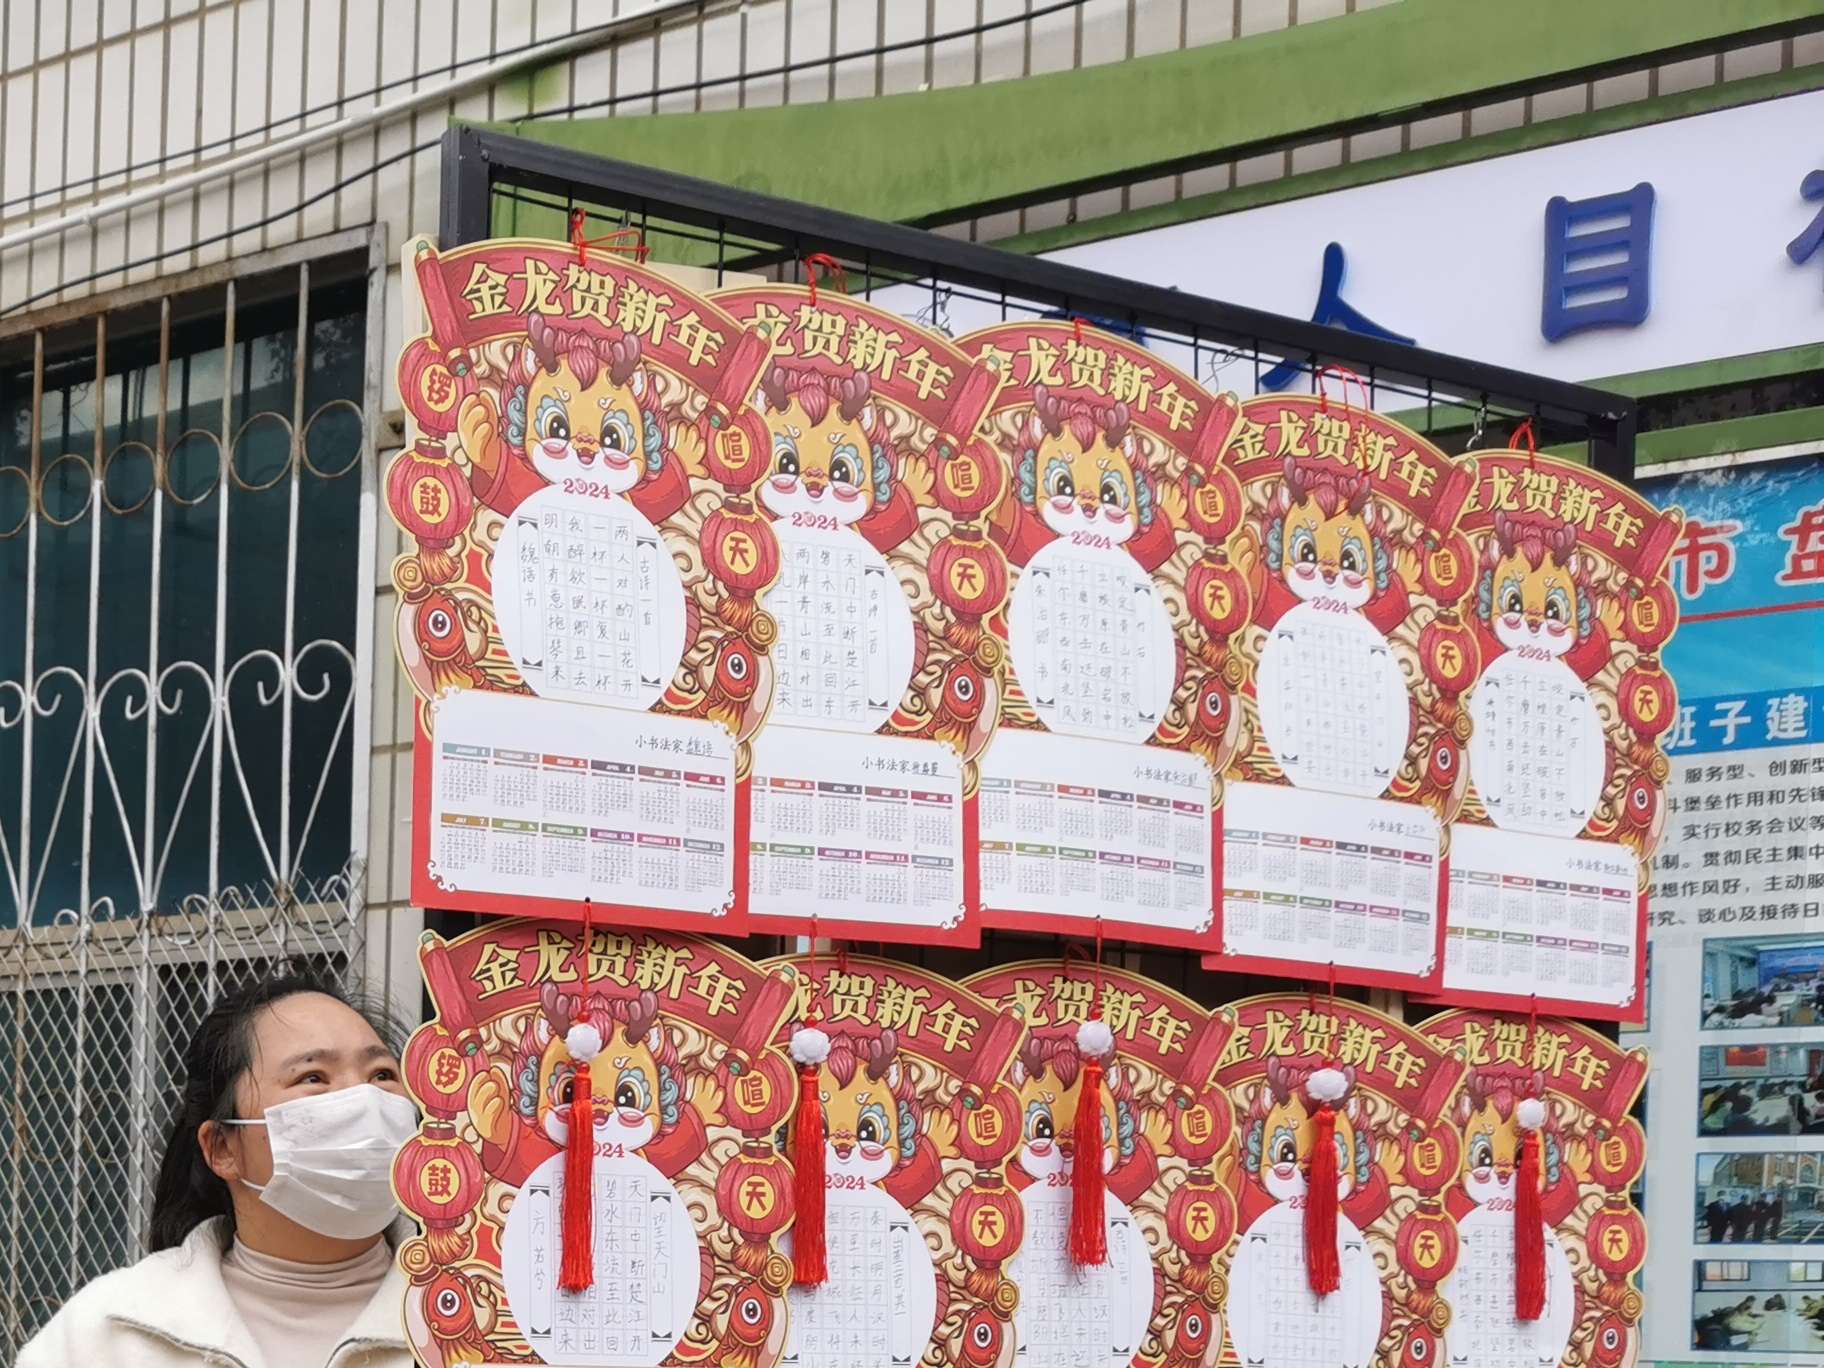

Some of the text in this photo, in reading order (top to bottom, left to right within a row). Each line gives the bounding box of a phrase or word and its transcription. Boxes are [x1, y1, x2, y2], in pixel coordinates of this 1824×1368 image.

[461, 258, 725, 368] 金龙贺新年
[1228, 410, 1437, 497] 金龙贺新年
[563, 479, 610, 499] 2024
[792, 513, 838, 531] 2024
[1071, 532, 1111, 549] 2024
[1312, 596, 1349, 614] 2024
[1517, 645, 1551, 661] 2024
[1663, 692, 1824, 750] 班子建
[635, 736, 682, 751] 小书法家
[862, 757, 910, 773] 小书法家
[1134, 766, 1172, 779] 小书法家
[1647, 902, 1824, 928] 究、谈心及接待日
[472, 928, 747, 1018] 金龙贺新年
[975, 976, 1192, 1055] 龙贺新年
[1220, 1009, 1426, 1088] 金龙贺新年
[825, 1175, 866, 1190] 2024
[1487, 1198, 1516, 1211] 202
